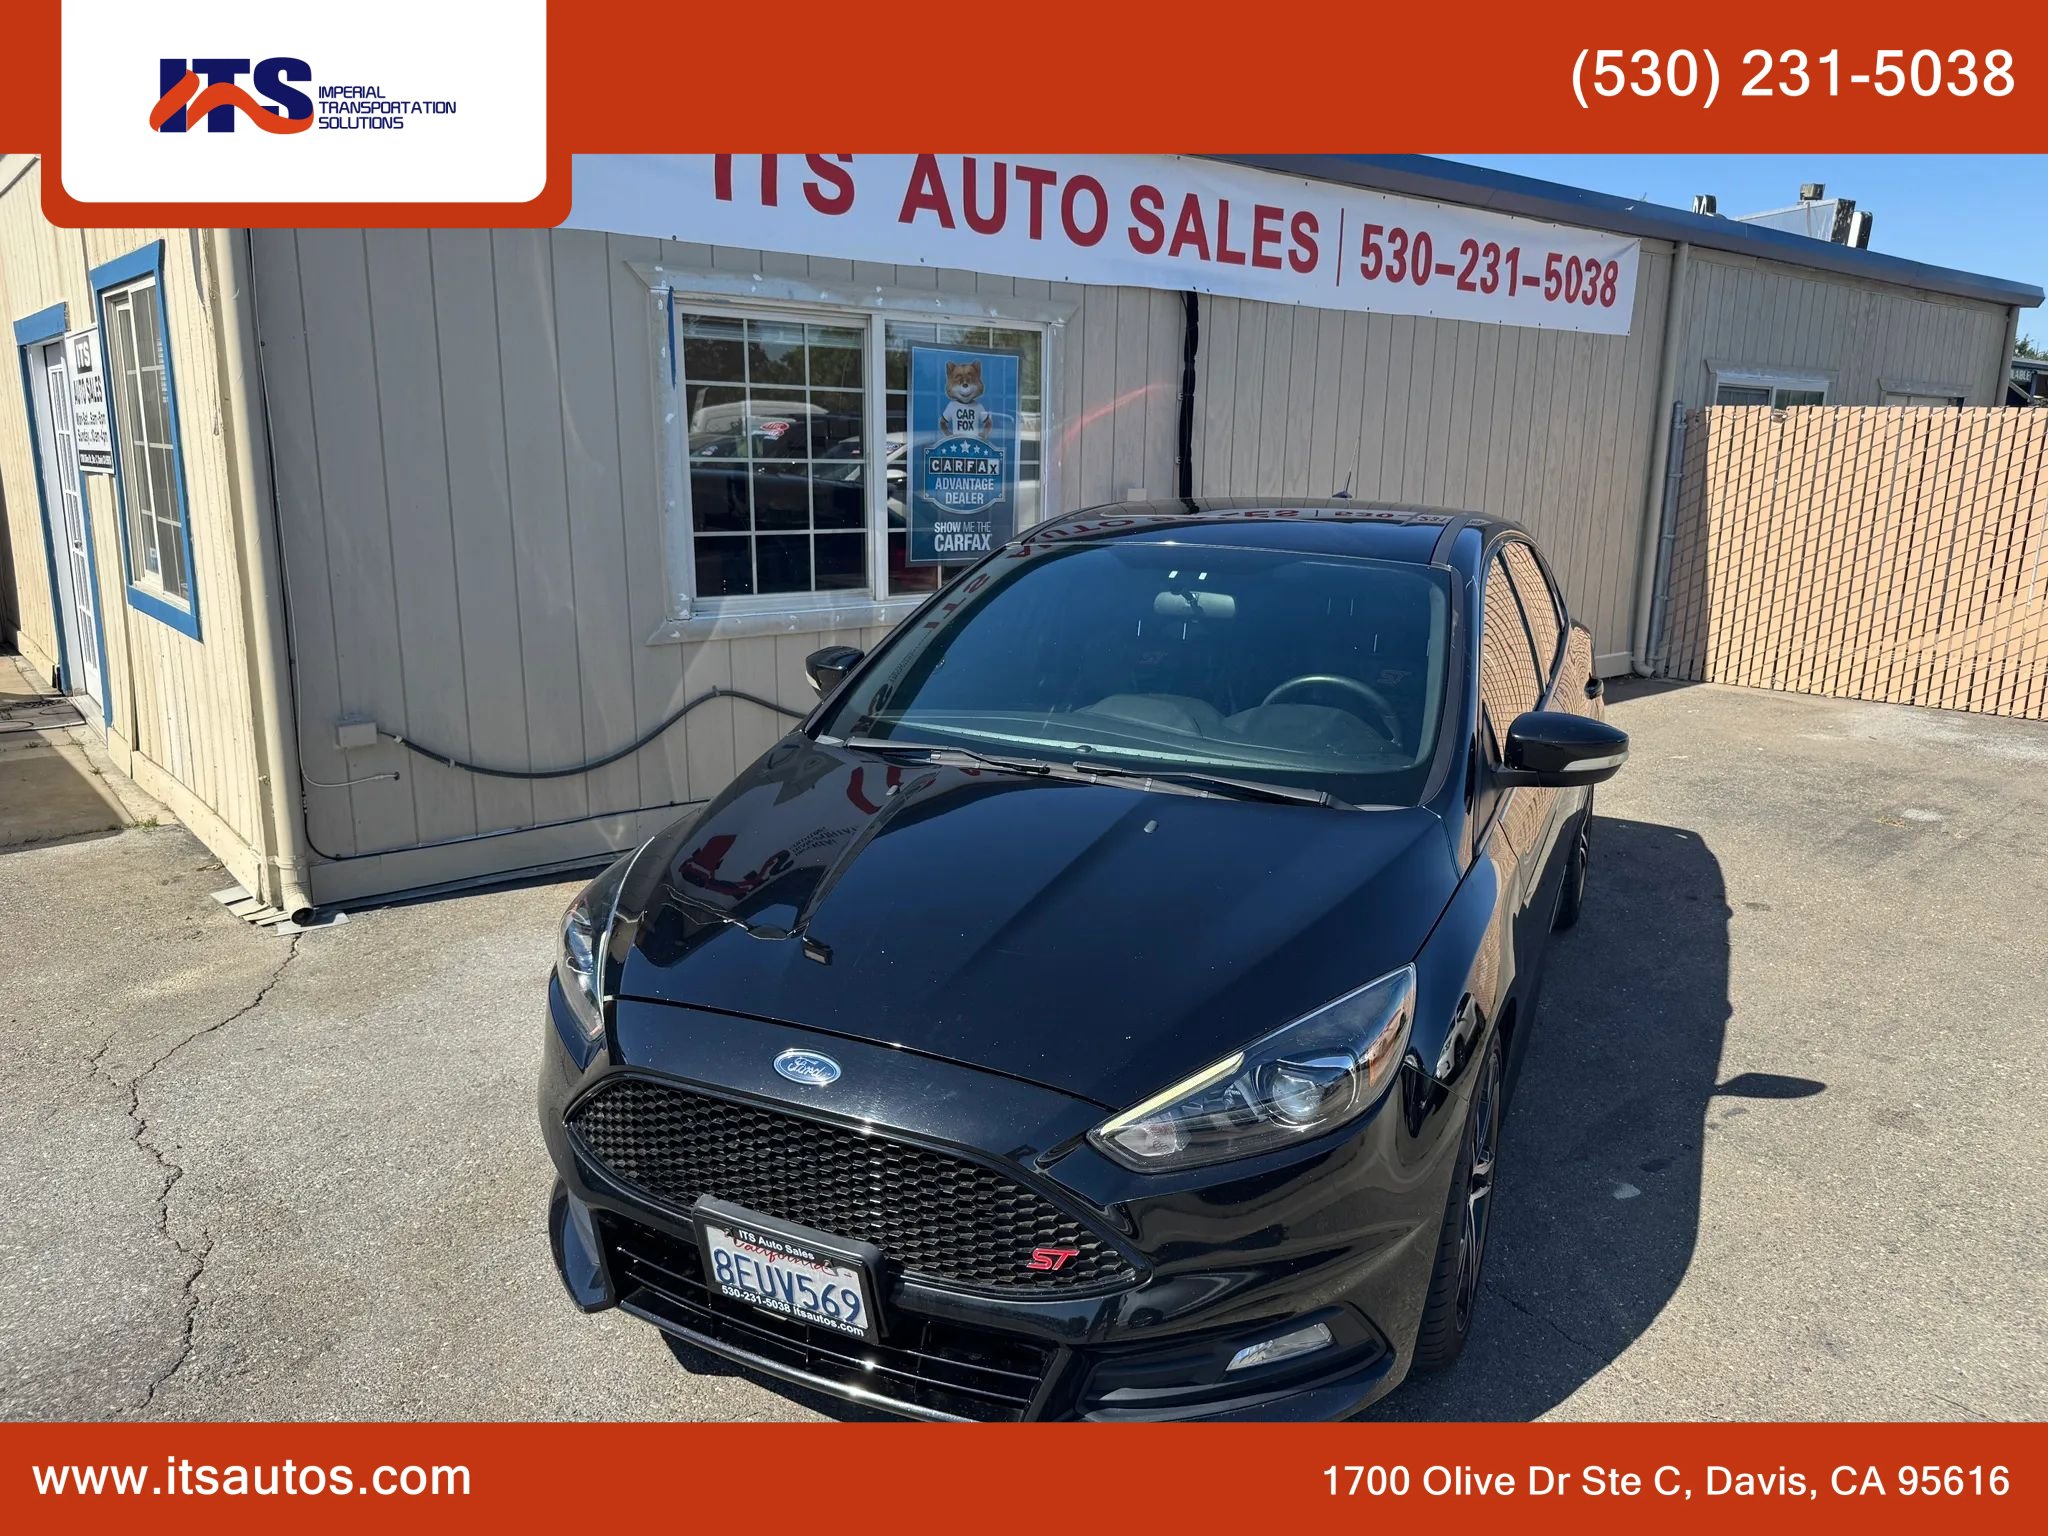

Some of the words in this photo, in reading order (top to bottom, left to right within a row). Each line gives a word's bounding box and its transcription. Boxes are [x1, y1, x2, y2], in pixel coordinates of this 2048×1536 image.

[898, 154, 1109, 247] AUTO
[1128, 184, 1319, 274] SALES
[1360, 223, 1619, 308] 530-231-5038
[76, 341, 91, 368] ITS
[956, 409, 975, 420] CAR
[957, 421, 975, 431] FOX
[931, 458, 998, 474] CARFAX
[935, 477, 995, 491] ADVANTAGE
[945, 492, 984, 504] DEALER
[934, 522, 962, 533] SHOW
[963, 522, 977, 532] ME
[977, 522, 991, 532] THE
[934, 534, 992, 551] CARFAX
[787, 1056, 828, 1078] Ford
[738, 1229, 756, 1244] ITS
[758, 1236, 783, 1251] Auto
[784, 1244, 815, 1260] Sales
[1026, 1248, 1080, 1271] ST
[713, 1247, 861, 1322] 8EUV569
[722, 1284, 791, 1313] 530-231-5038
[793, 1302, 865, 1337] itsautos.com
